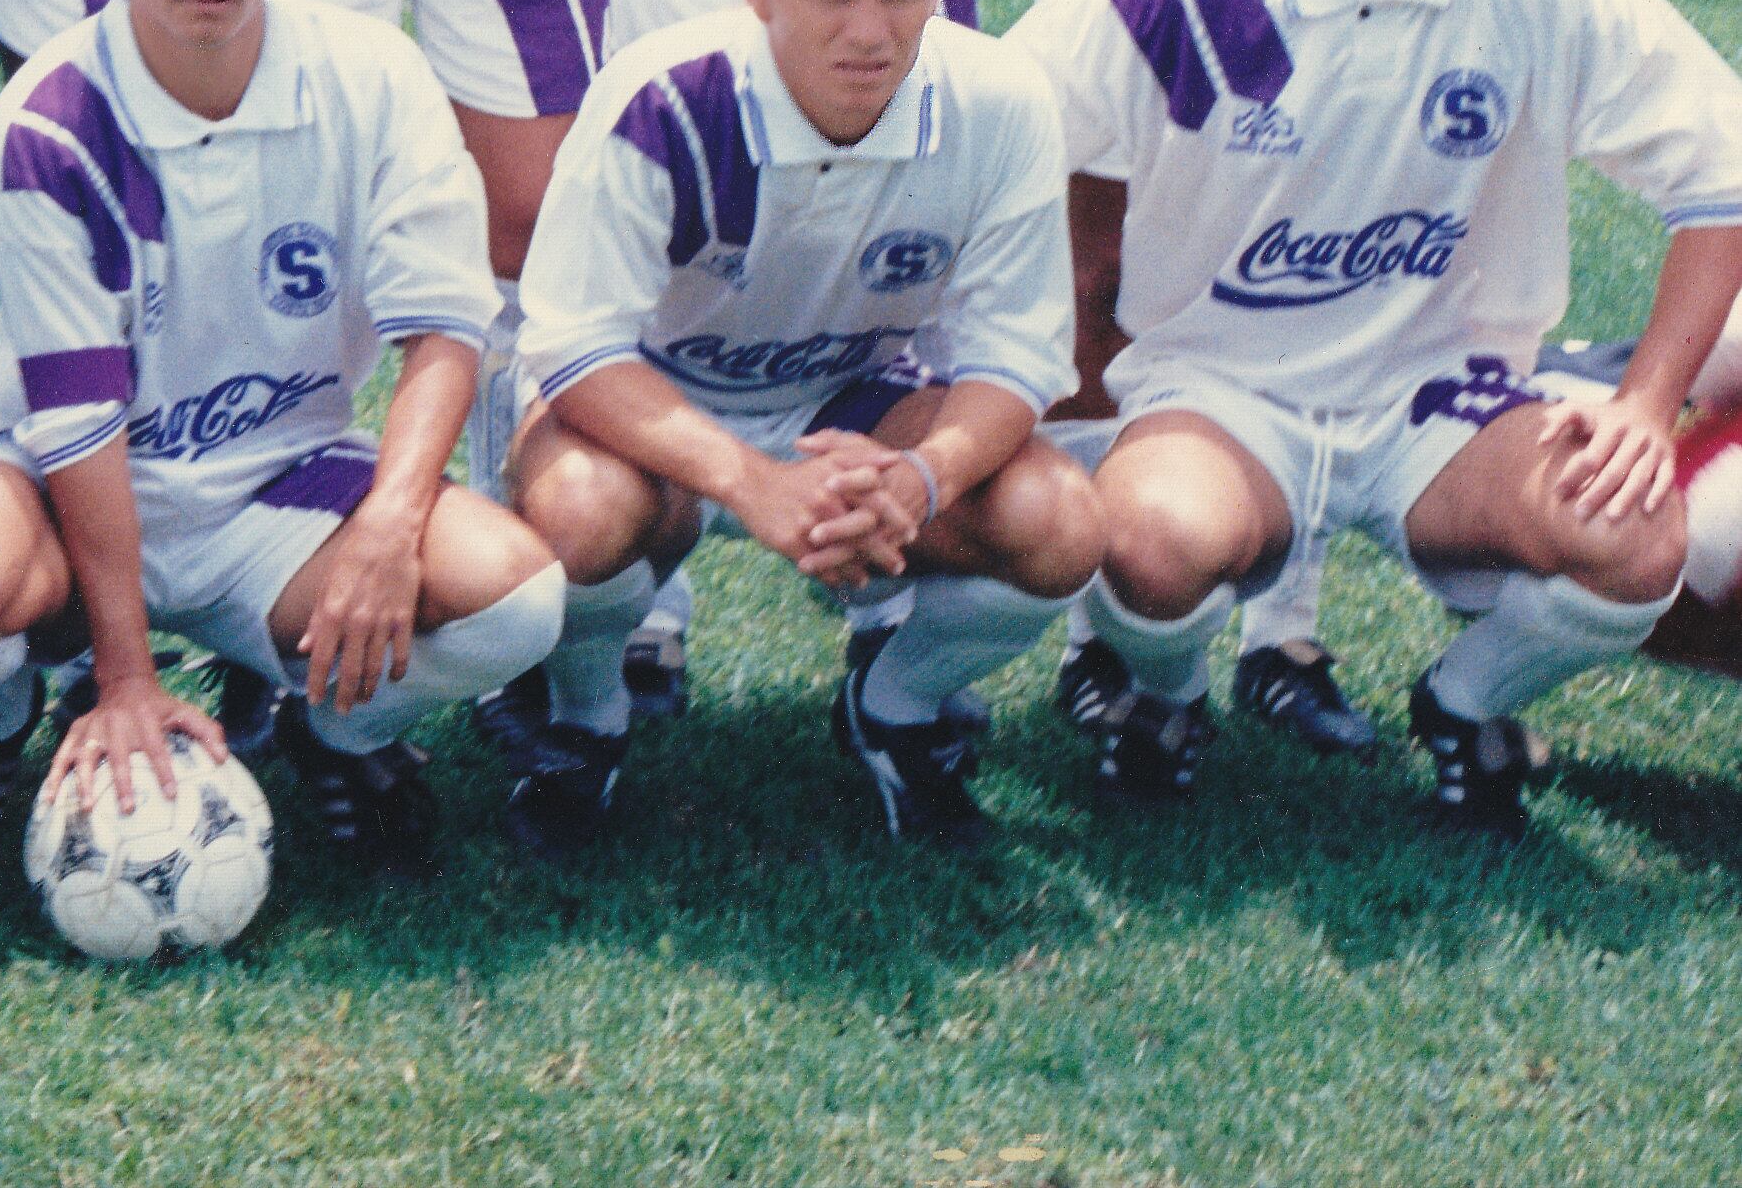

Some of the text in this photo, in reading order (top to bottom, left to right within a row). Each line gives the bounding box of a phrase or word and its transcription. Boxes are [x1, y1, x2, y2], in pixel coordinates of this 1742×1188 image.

[1444, 87, 1488, 141] S
[276, 240, 329, 300] S
[1237, 210, 1469, 284] Coca-Cola
